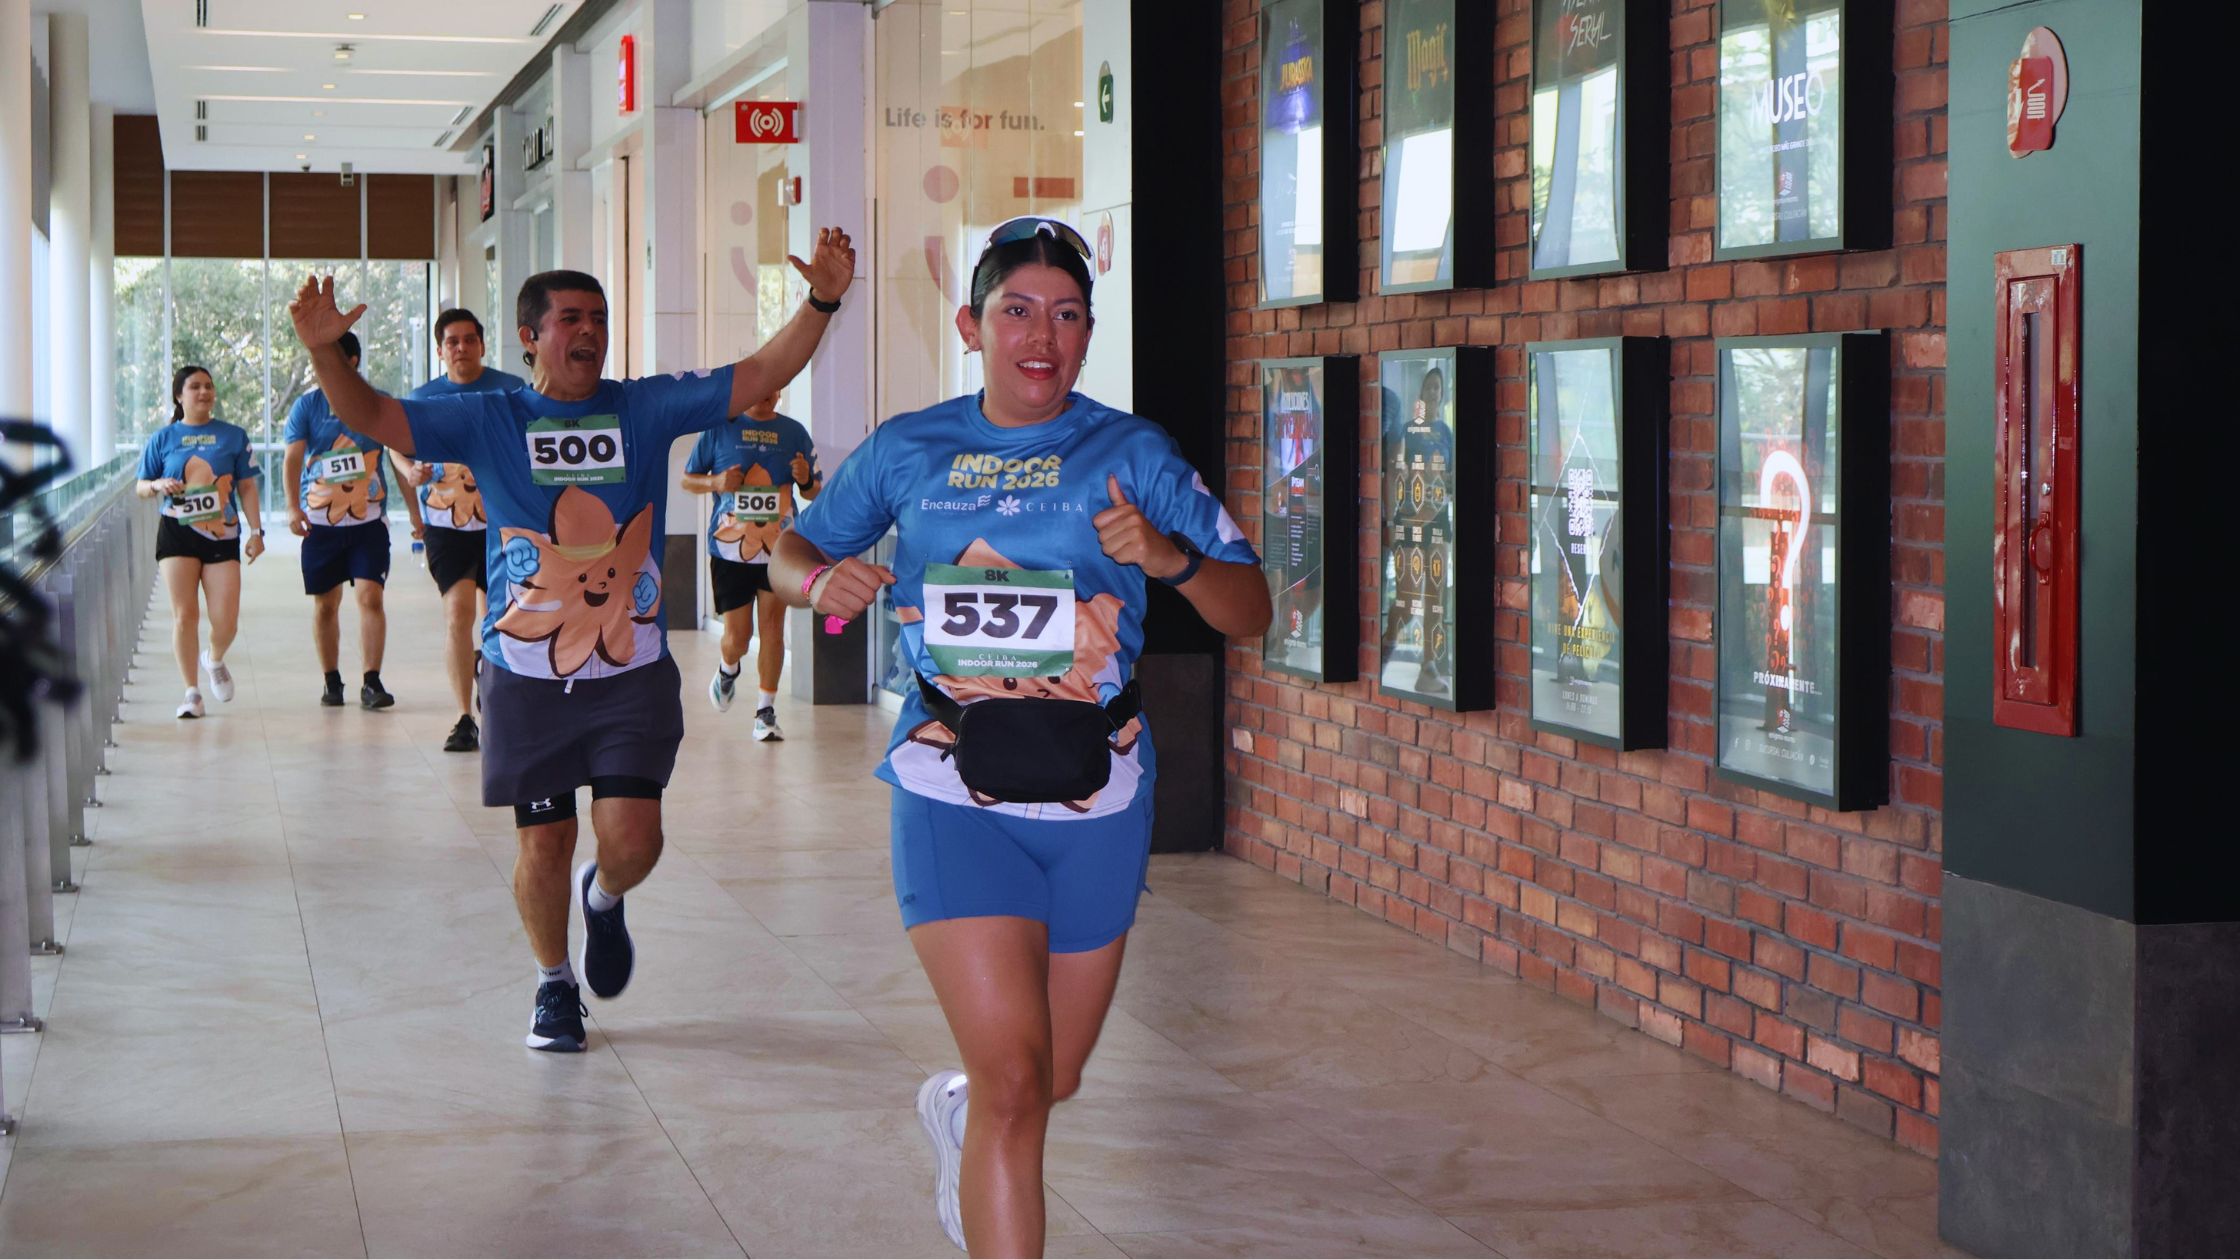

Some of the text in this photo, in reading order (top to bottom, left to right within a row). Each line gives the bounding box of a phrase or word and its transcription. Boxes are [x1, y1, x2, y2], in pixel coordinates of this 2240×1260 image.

[1751, 70, 1824, 128] MUSEO
[885, 107, 1045, 131] Life is for fun.
[534, 434, 617, 465] 500
[330, 456, 357, 473] 511
[952, 453, 1063, 475] INDOOR
[947, 471, 1060, 490] RUN 2026
[183, 496, 215, 513] 510
[738, 495, 777, 511] 506
[921, 499, 1083, 513] Encauza CEIBA
[984, 569, 1010, 582] 8K
[941, 592, 1058, 640] 537
[958, 659, 993, 667] INDOOR
[1015, 661, 1038, 669] 2026
